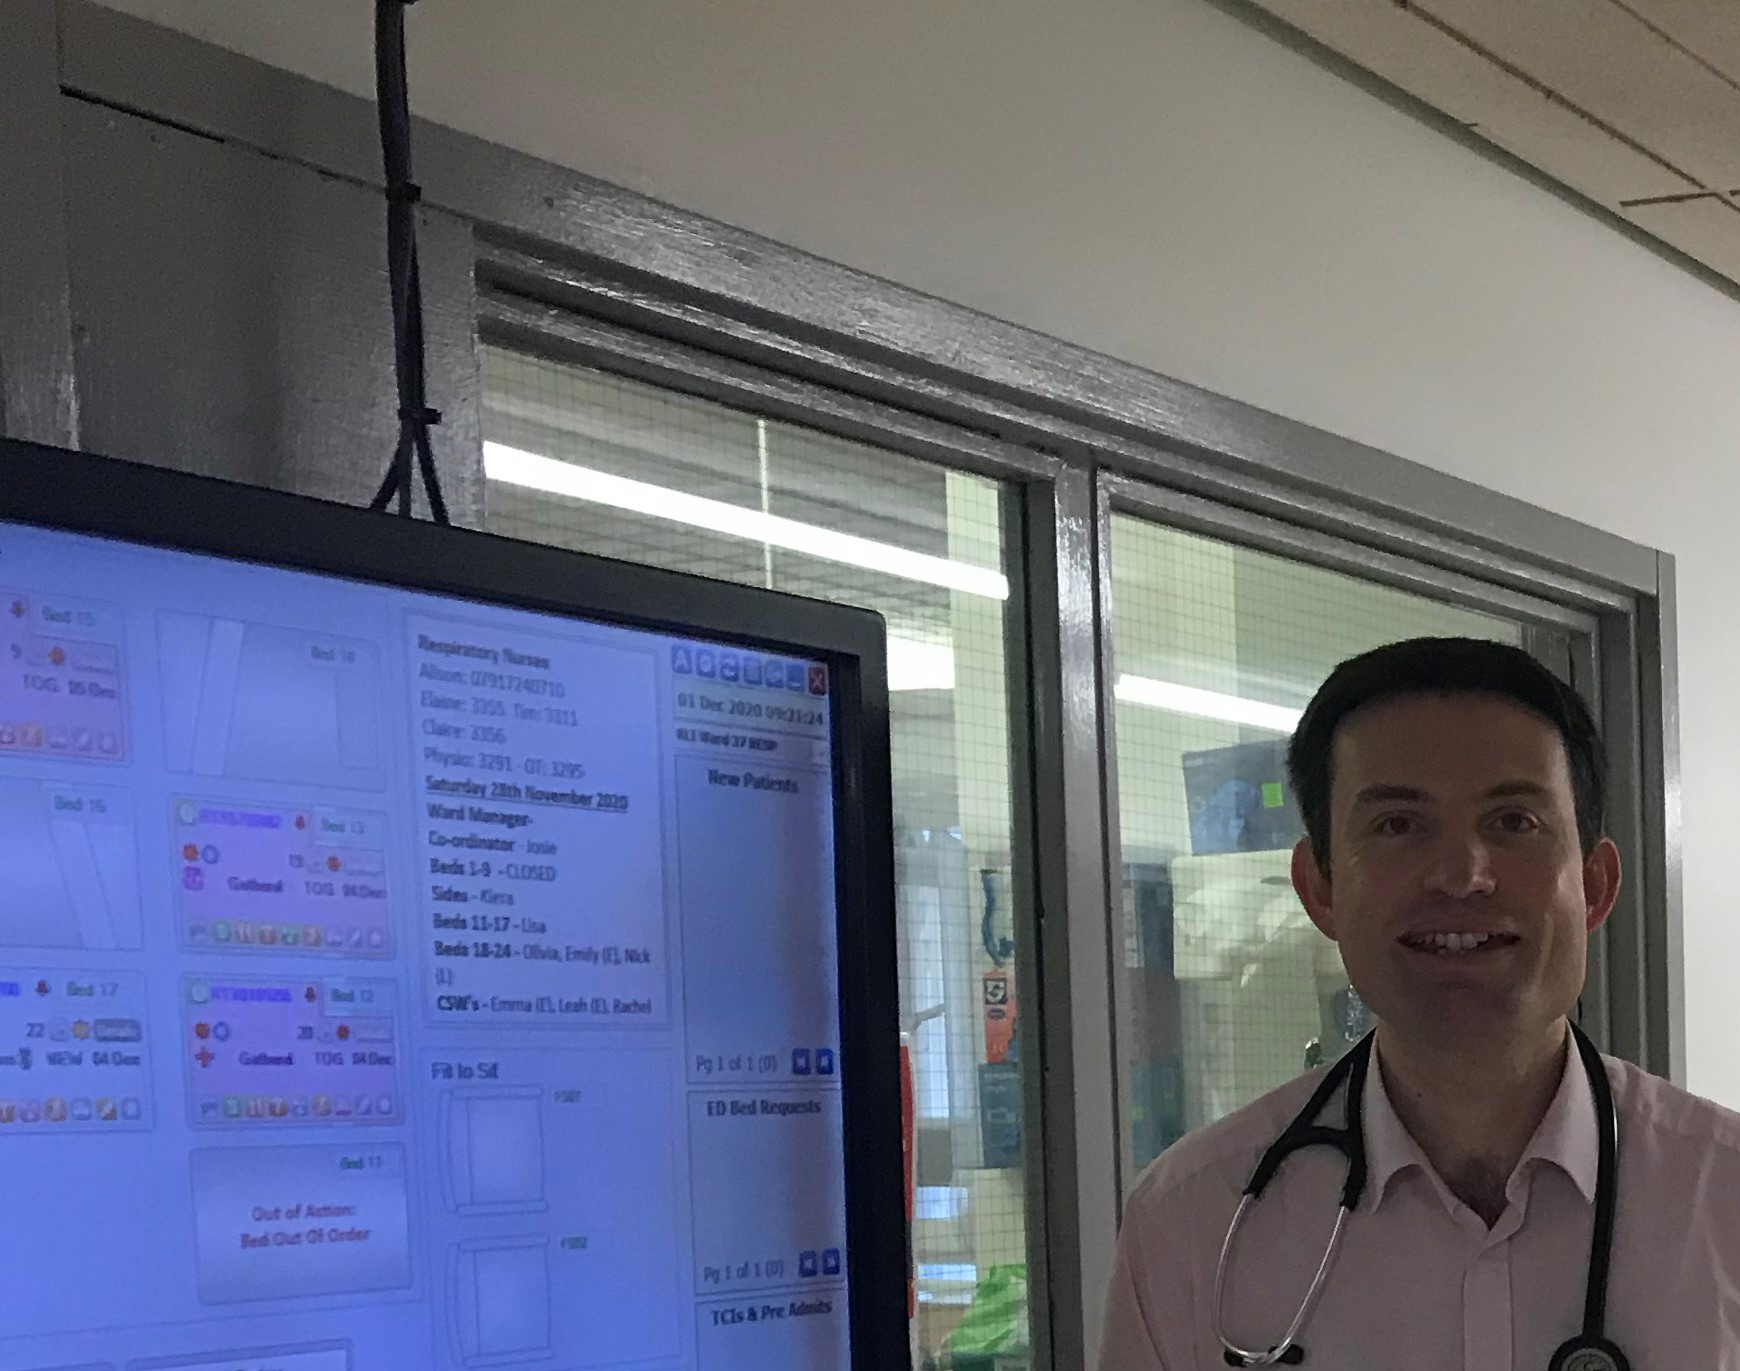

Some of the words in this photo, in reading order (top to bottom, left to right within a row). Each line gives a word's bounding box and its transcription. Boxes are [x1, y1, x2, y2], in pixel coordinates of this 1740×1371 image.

[418, 633, 498, 664] Respiratory
[503, 648, 551, 669] Nurses
[700, 695, 724, 712] Dec
[729, 699, 762, 716] 2020
[700, 731, 730, 746] Ward
[708, 768, 740, 787] New
[743, 771, 800, 793] Patients
[425, 775, 487, 798] Saturday
[525, 785, 593, 806] November
[596, 792, 629, 809] 2020
[427, 802, 465, 821] Ward
[430, 858, 465, 875] Beds
[433, 913, 467, 930] Beds
[434, 941, 469, 957] Beds
[490, 997, 532, 1013] Emma
[559, 998, 588, 1014] Leah
[613, 998, 652, 1014] Rachel
[696, 1055, 712, 1074] Pg
[730, 1100, 756, 1115] Bed
[760, 1099, 821, 1117] Requests
[252, 1205, 281, 1222] Out
[285, 1203, 302, 1220] of
[272, 1231, 302, 1246] Out
[327, 1228, 370, 1243] Order
[704, 1266, 720, 1284] Pg
[761, 1304, 784, 1320] Pre
